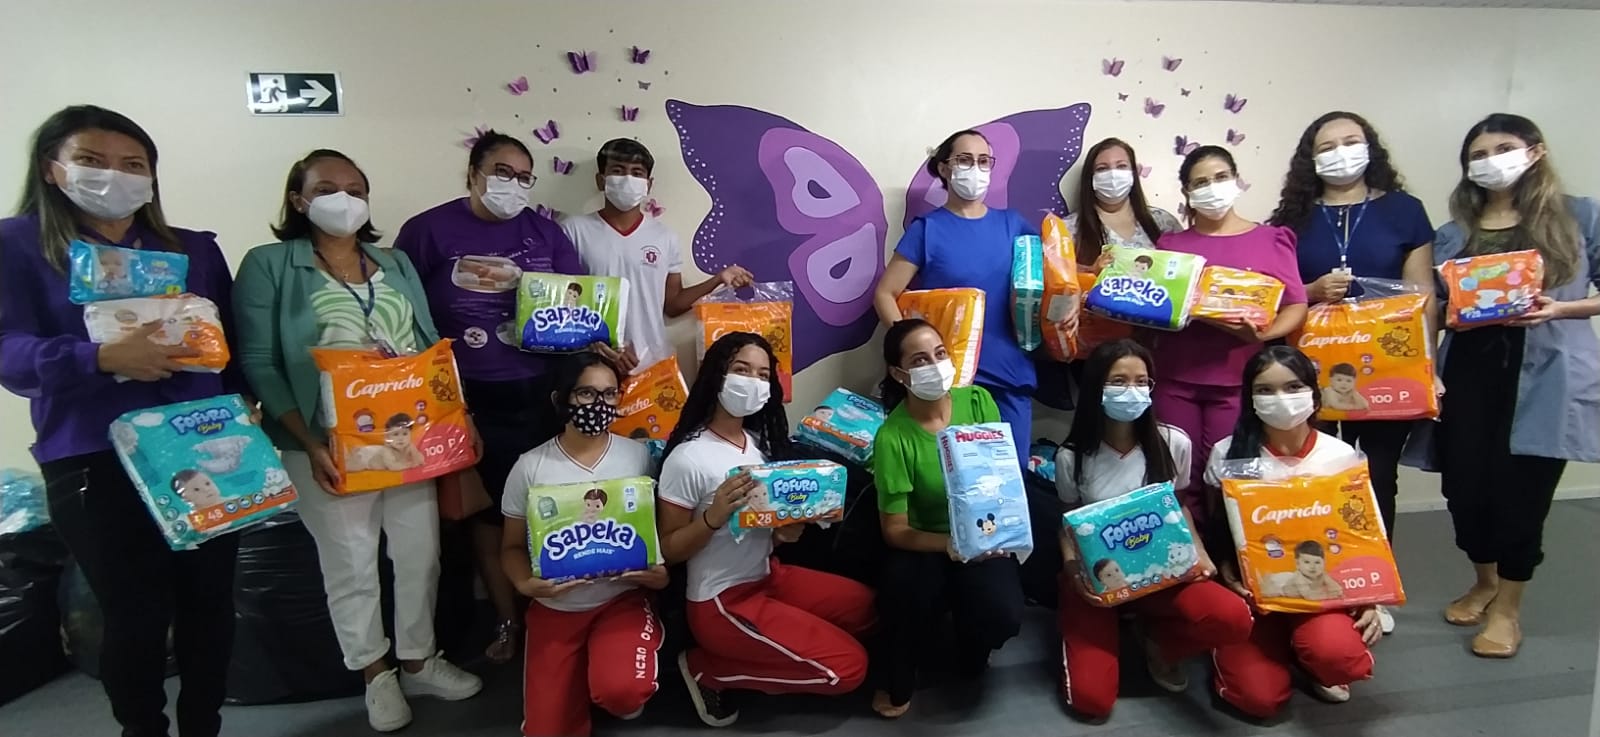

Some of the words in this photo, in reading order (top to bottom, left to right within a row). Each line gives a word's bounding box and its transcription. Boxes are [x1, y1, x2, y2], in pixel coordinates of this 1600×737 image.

[1102, 277, 1166, 304] Sapeka
[532, 306, 602, 331] Sapeka
[1299, 330, 1372, 349] Capricho
[345, 373, 424, 399] Capricho
[1369, 394, 1393, 404] 100
[1399, 390, 1410, 401] P
[955, 430, 1005, 443] HUGGIES
[425, 445, 444, 457] 100
[448, 438, 456, 449] P
[772, 479, 819, 498] FOFURA
[208, 508, 224, 521] 48
[745, 514, 755, 525] P
[758, 513, 773, 524] 28
[1251, 500, 1332, 525] Capricho
[546, 519, 634, 557] Sapeka
[1101, 512, 1162, 549] FOFURA
[1125, 533, 1151, 549] Baby
[1342, 577, 1366, 589] 100
[1370, 571, 1380, 584] P
[1116, 589, 1130, 600] 48
